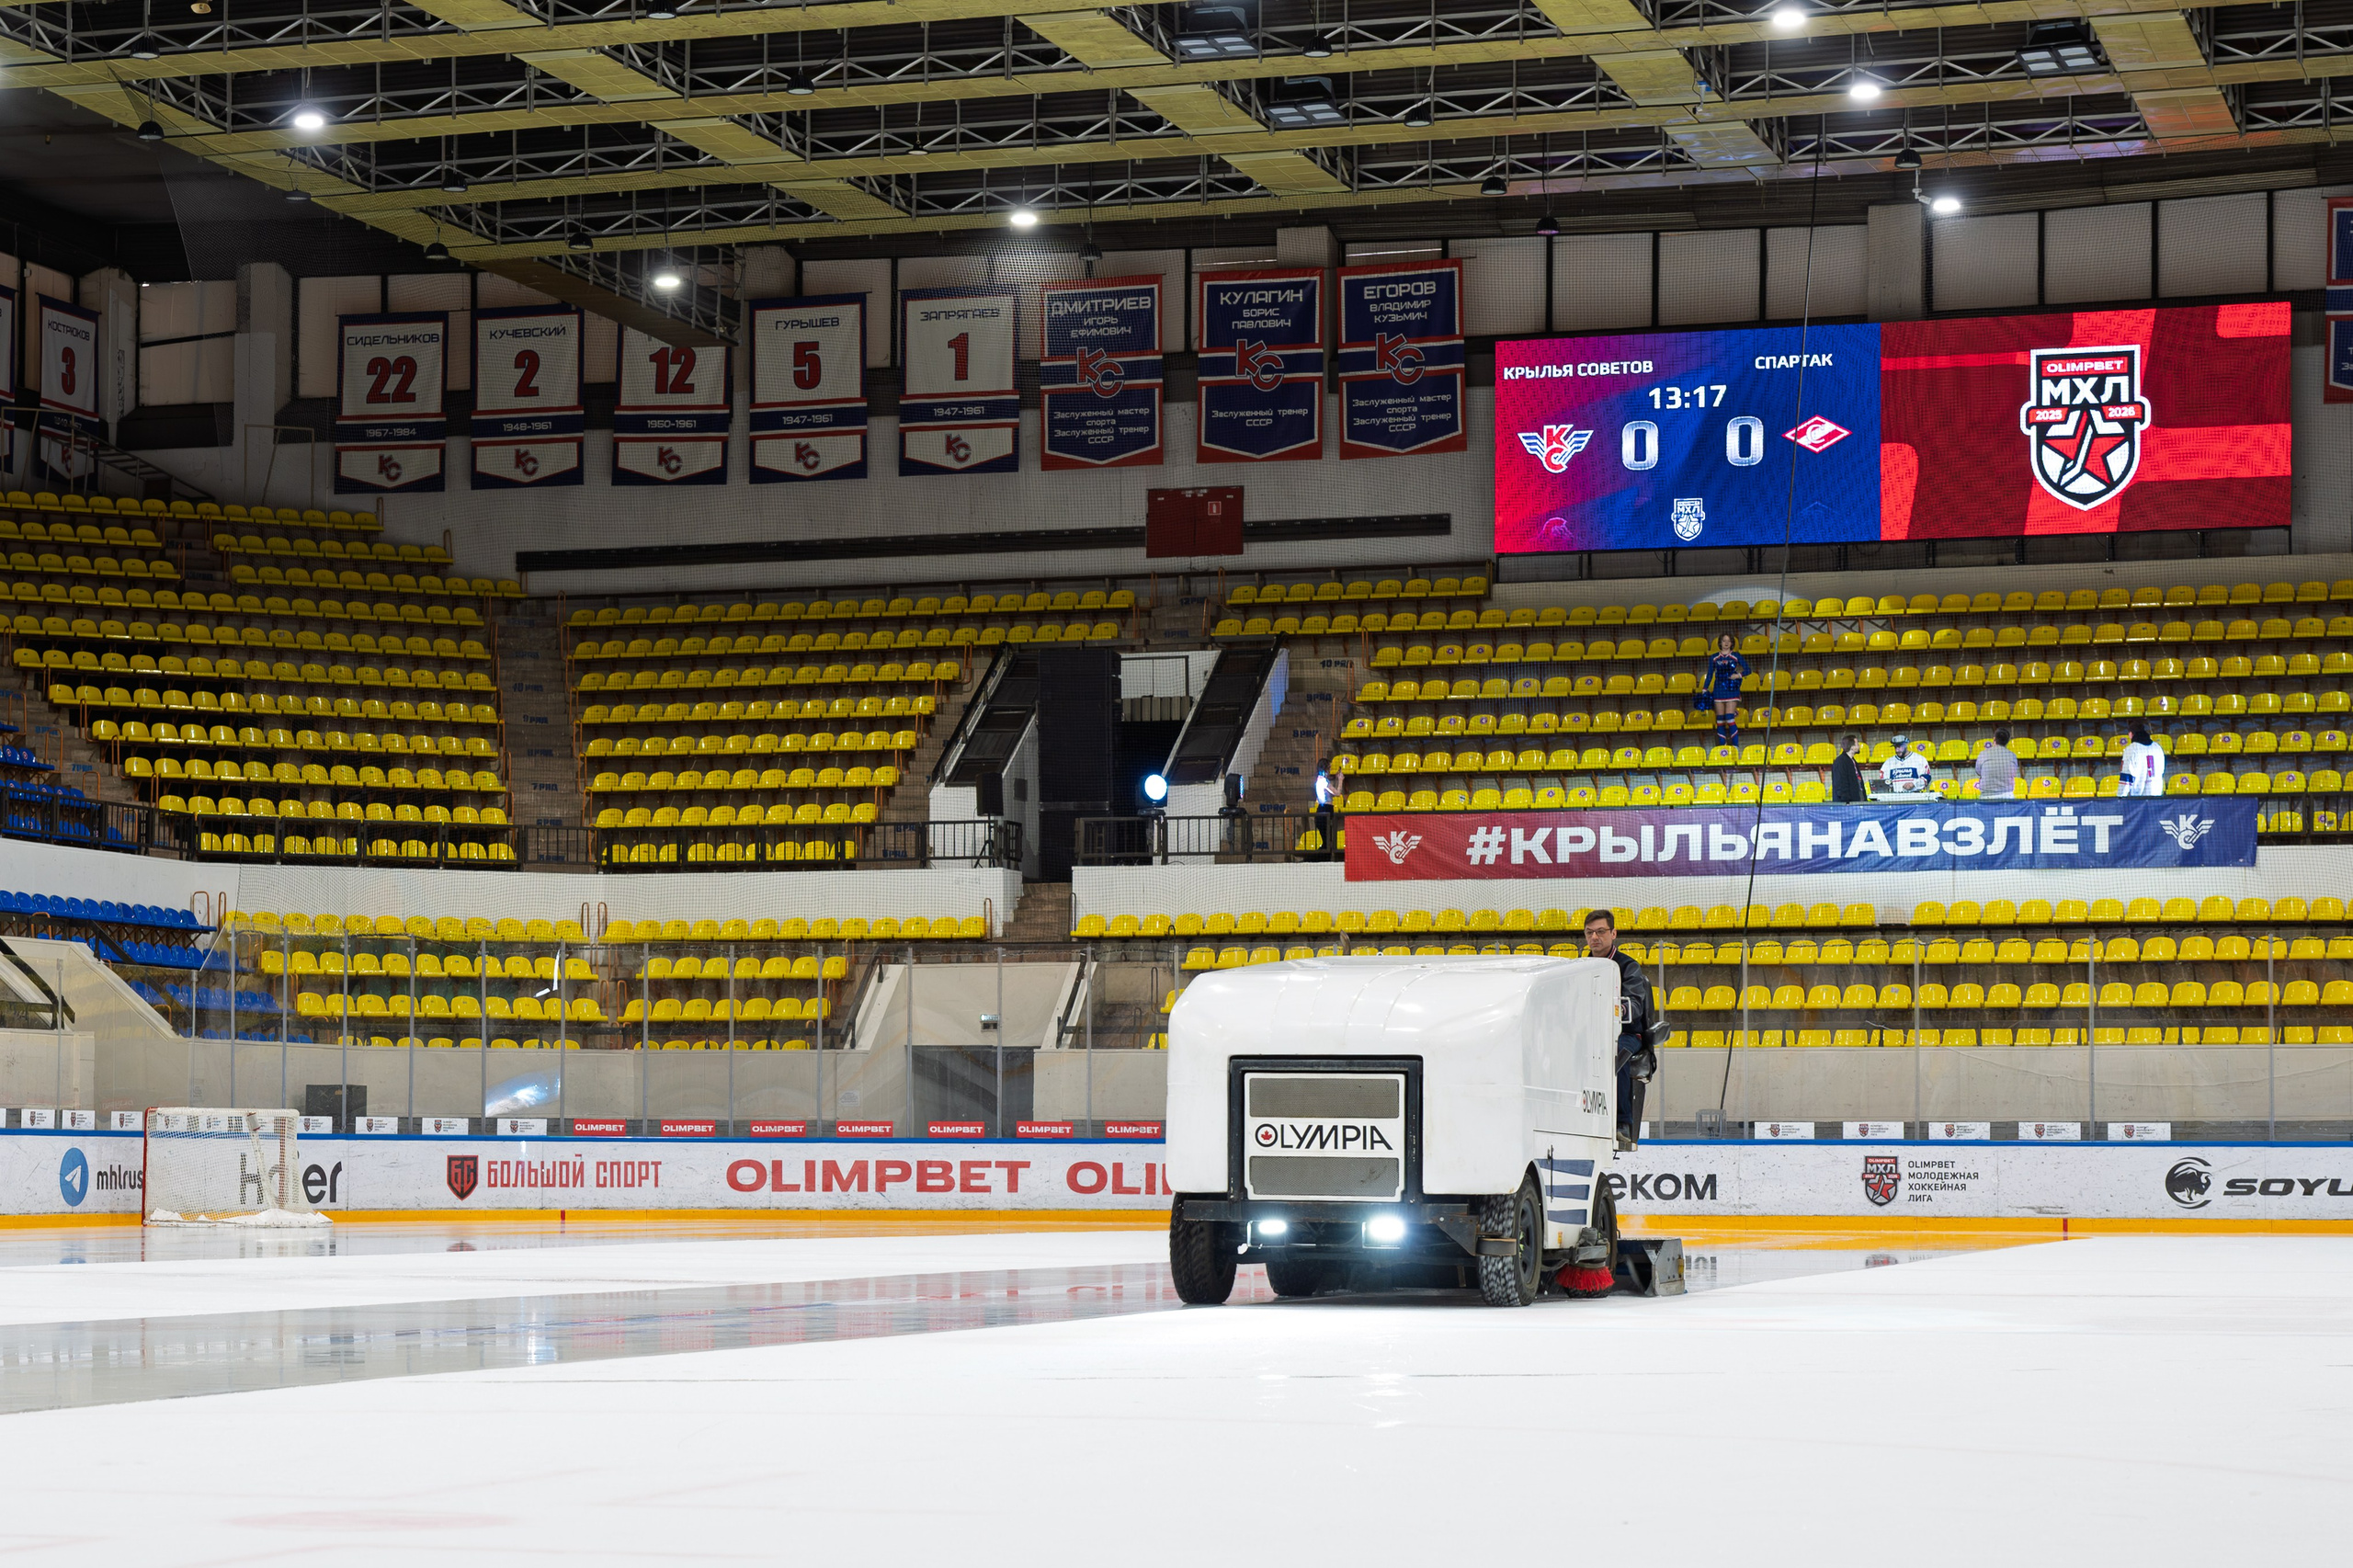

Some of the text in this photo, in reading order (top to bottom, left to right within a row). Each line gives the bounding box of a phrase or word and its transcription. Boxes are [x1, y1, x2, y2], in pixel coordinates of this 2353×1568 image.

[1363, 280, 1437, 300] ЕГОРОВ
[1220, 289, 1304, 306] КУЛАГИН
[1050, 296, 1152, 318] ДМИТРИЕВ
[1370, 299, 1432, 312] ВЛАДИМИР
[1243, 308, 1280, 318] БОРИС
[1373, 311, 1428, 324] КУЗЬМИЧ
[775, 317, 839, 330] ГУРЫШЕВ
[1083, 316, 1119, 326] ИГОРЬ
[1232, 319, 1291, 330] ПАВЛОВИЧ
[47, 319, 90, 341] КОСТРЮКОВ
[489, 324, 566, 340] КУЧЕВСКИЙ
[1071, 326, 1131, 338] ЕФИМОВИЧ
[347, 333, 439, 347] СИДЕЛЬНИКОВ
[948, 332, 969, 381] 1
[1755, 353, 1834, 370] СПАРТАК
[61, 346, 76, 395] 3
[649, 347, 697, 394] 12
[793, 341, 822, 390] 5
[1503, 359, 1654, 380] КРЫЛЬЯ СОВЕТОВ
[2046, 359, 2124, 374] OLIMPBET
[514, 349, 540, 397] 2
[366, 356, 417, 403] 22
[2041, 375, 2130, 406] МХЛ
[1352, 395, 1451, 407] Заслуженный мастер
[1648, 384, 1727, 410] 13:17
[933, 405, 985, 417] 1947-1961
[1053, 407, 1150, 420] Заслуженный мастер
[1211, 407, 1308, 419] Заслуженный тренер
[1386, 404, 1418, 415] спорта
[2035, 410, 2063, 421] 2025
[2108, 406, 2136, 418] 2026
[646, 418, 697, 428] 1950-1961
[782, 413, 834, 426] 1947-1961
[1086, 417, 1117, 428] спорта
[1245, 418, 1273, 427] СССР
[1353, 414, 1451, 426] Заслуженный тренер
[365, 427, 417, 437] 1967-1984
[503, 420, 552, 432] 1948-1961
[1053, 426, 1150, 438] Заслуженный тренер
[1388, 423, 1416, 433] СССР
[1087, 435, 1115, 445] СССР
[1621, 420, 1659, 471] 0
[1725, 415, 1765, 467] 0
[1466, 807, 2123, 865] #КРЫЛЬЯНАВЗЛЁТ
[1582, 1090, 1608, 1116] OLYMPIA
[574, 1124, 625, 1132] OLIMPBET
[662, 1125, 714, 1133] OLIMPBET
[752, 1125, 805, 1133] OLIMPBET
[837, 1124, 892, 1133] OLIMPBET
[929, 1125, 983, 1134] OLIMPBET
[1017, 1125, 1072, 1133] OLIMPBET
[1106, 1125, 1159, 1134] OLIMPBET
[1255, 1123, 1393, 1151] OLYMPIA
[487, 1153, 662, 1188] БОЛЬШОЙ СПОРТ
[1867, 1164, 1896, 1174] МХЛ
[1907, 1160, 1956, 1169] OLIMPBET
[726, 1159, 1031, 1193] OLIMPBET
[1907, 1172, 1979, 1181] МОЛОДЕЖНАЯ
[1907, 1181, 1967, 1191] ХОККЕЙНАЯ
[1907, 1194, 1933, 1202] ЛИГА
